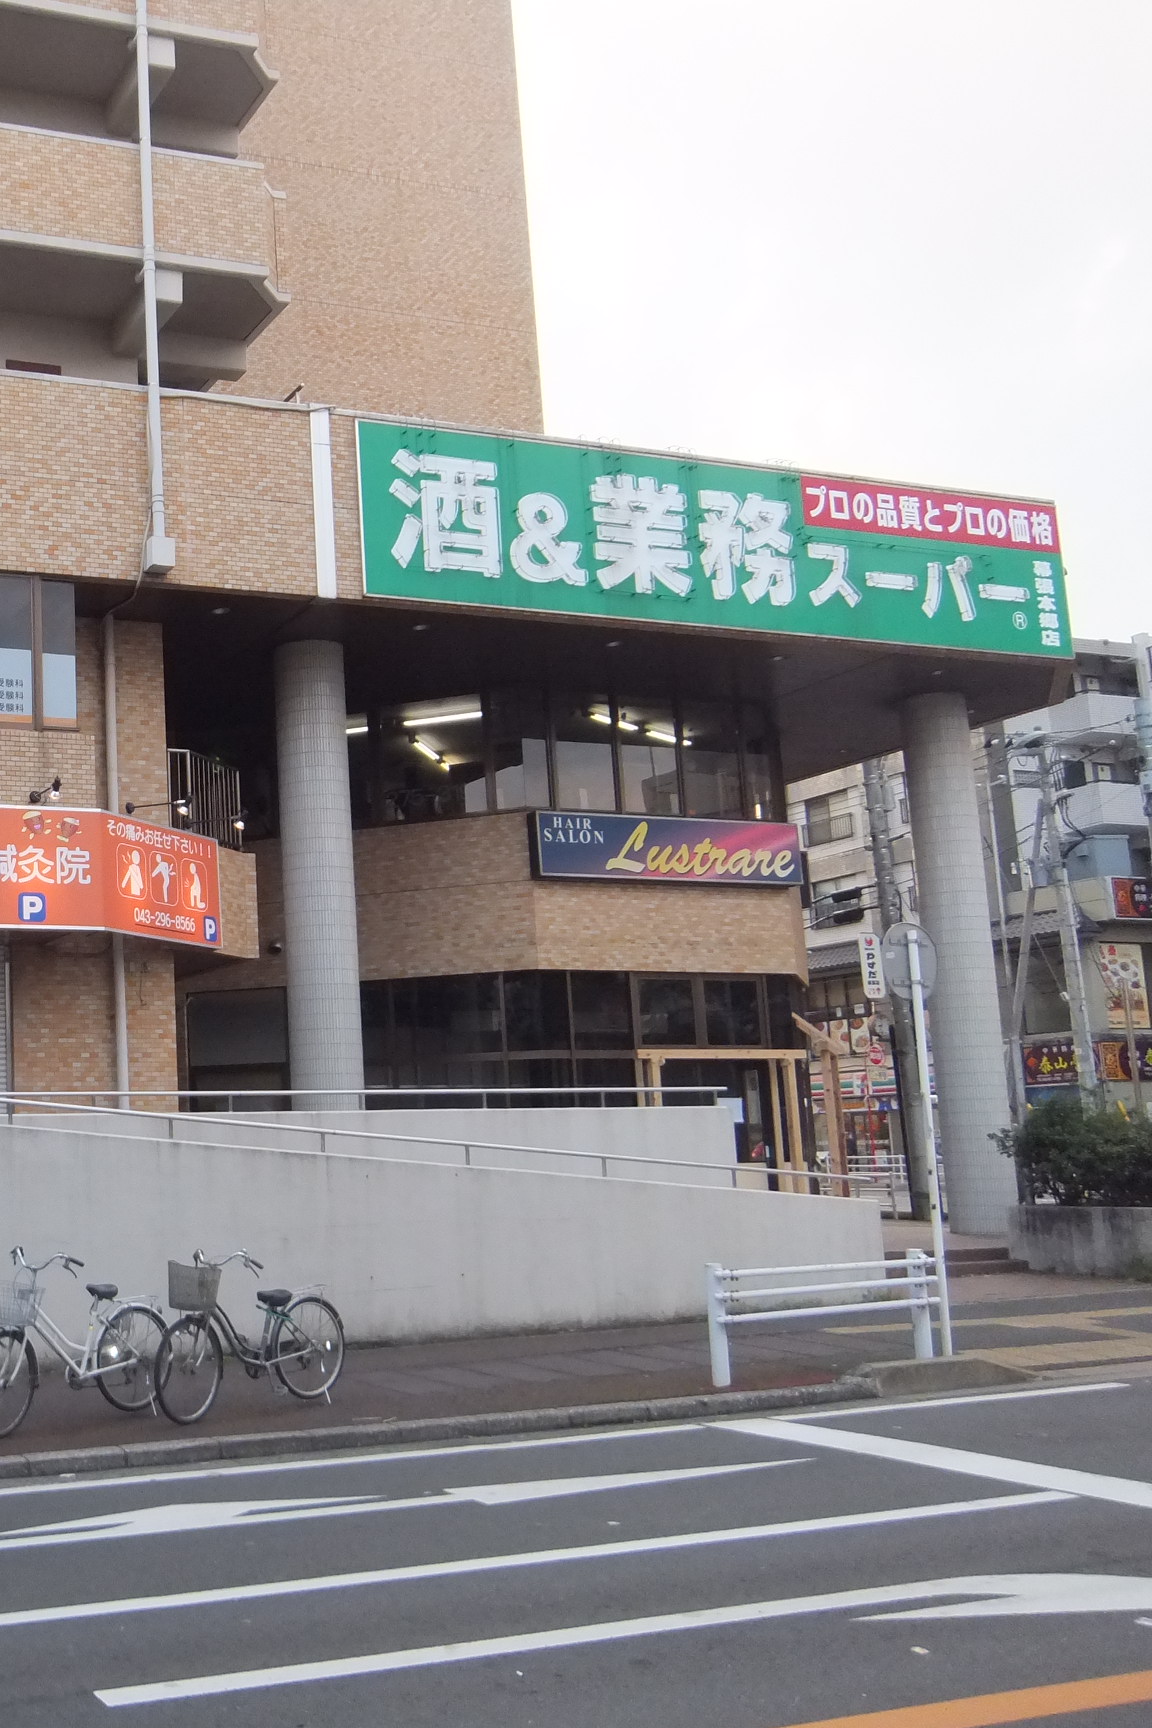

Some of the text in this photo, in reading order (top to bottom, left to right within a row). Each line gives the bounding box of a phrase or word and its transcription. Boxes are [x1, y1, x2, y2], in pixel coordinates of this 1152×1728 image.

[806, 485, 1054, 546] プロの品質とプロの価格
[553, 816, 592, 830] HAIR
[544, 828, 605, 844] SALON
[605, 820, 796, 878] Lustrare
[22, 896, 44, 920] P
[134, 907, 196, 932] 043-296-8566
